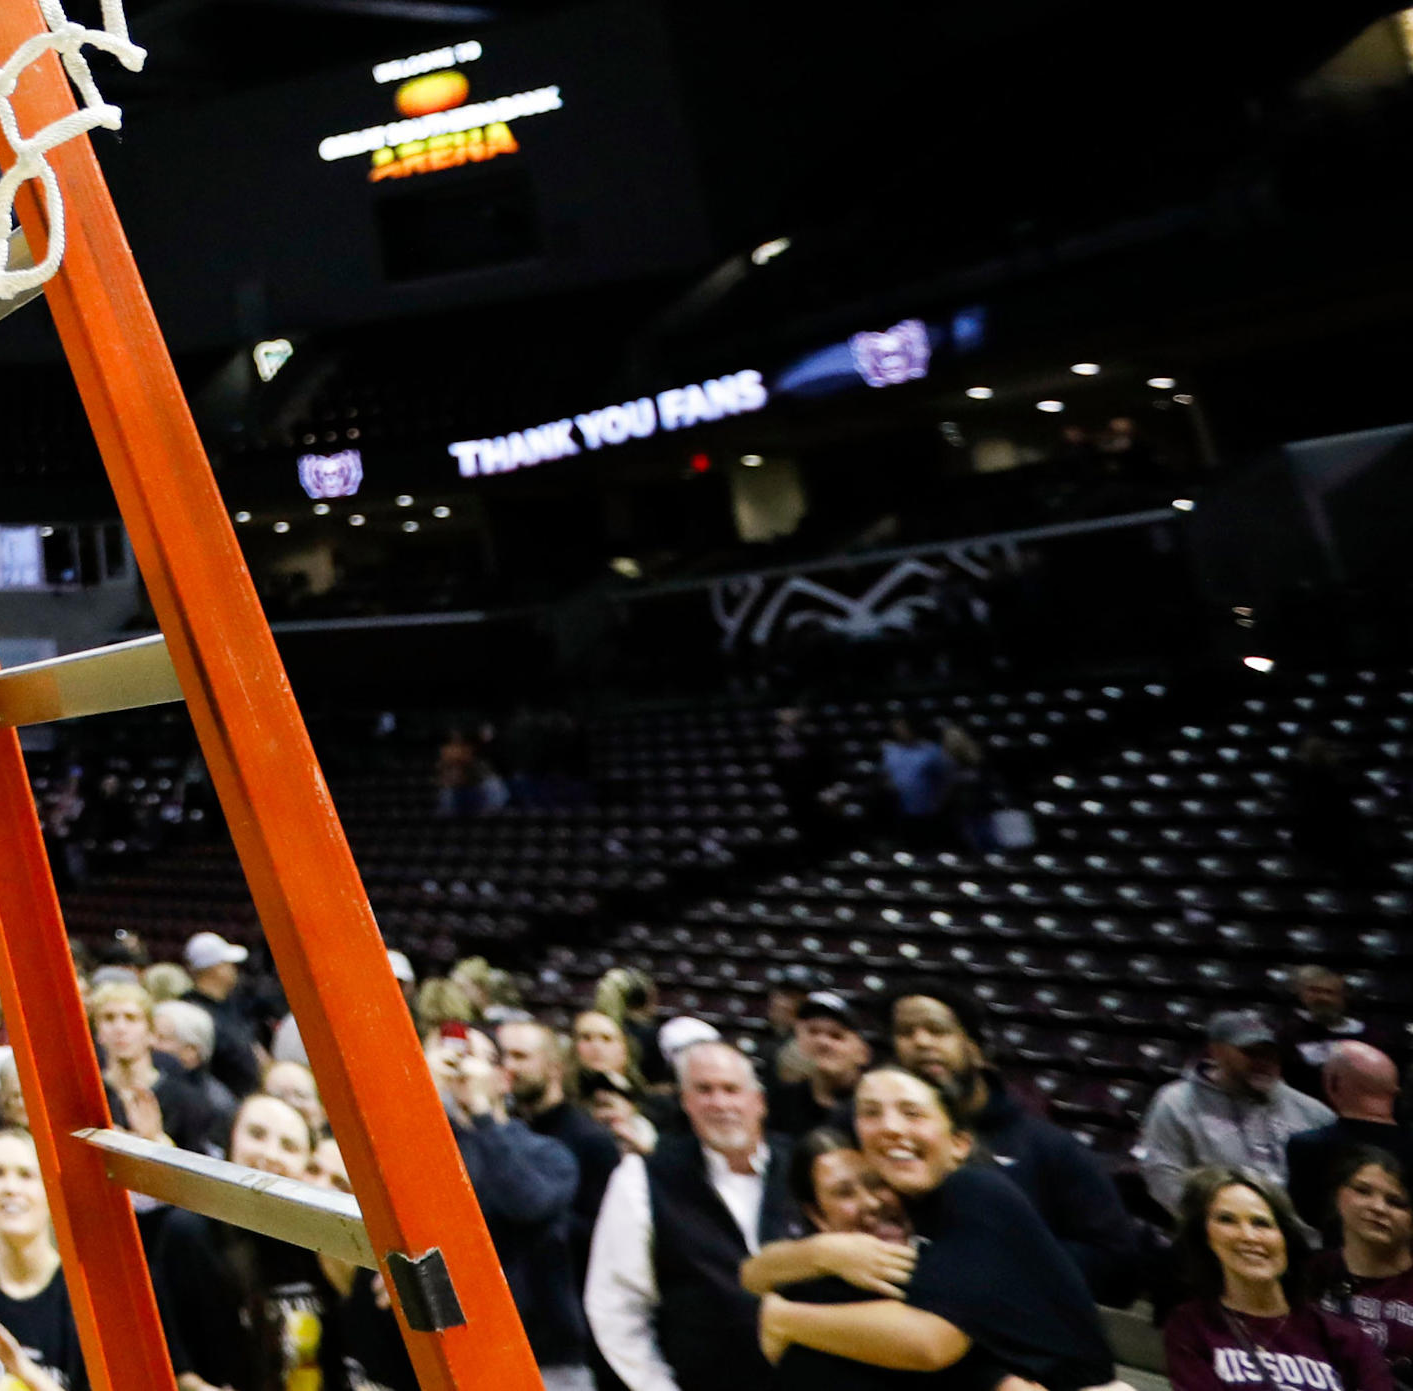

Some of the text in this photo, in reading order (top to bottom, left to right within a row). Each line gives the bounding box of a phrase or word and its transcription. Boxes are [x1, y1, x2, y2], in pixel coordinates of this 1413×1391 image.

[448, 369, 768, 477] THANK YOU FANS
